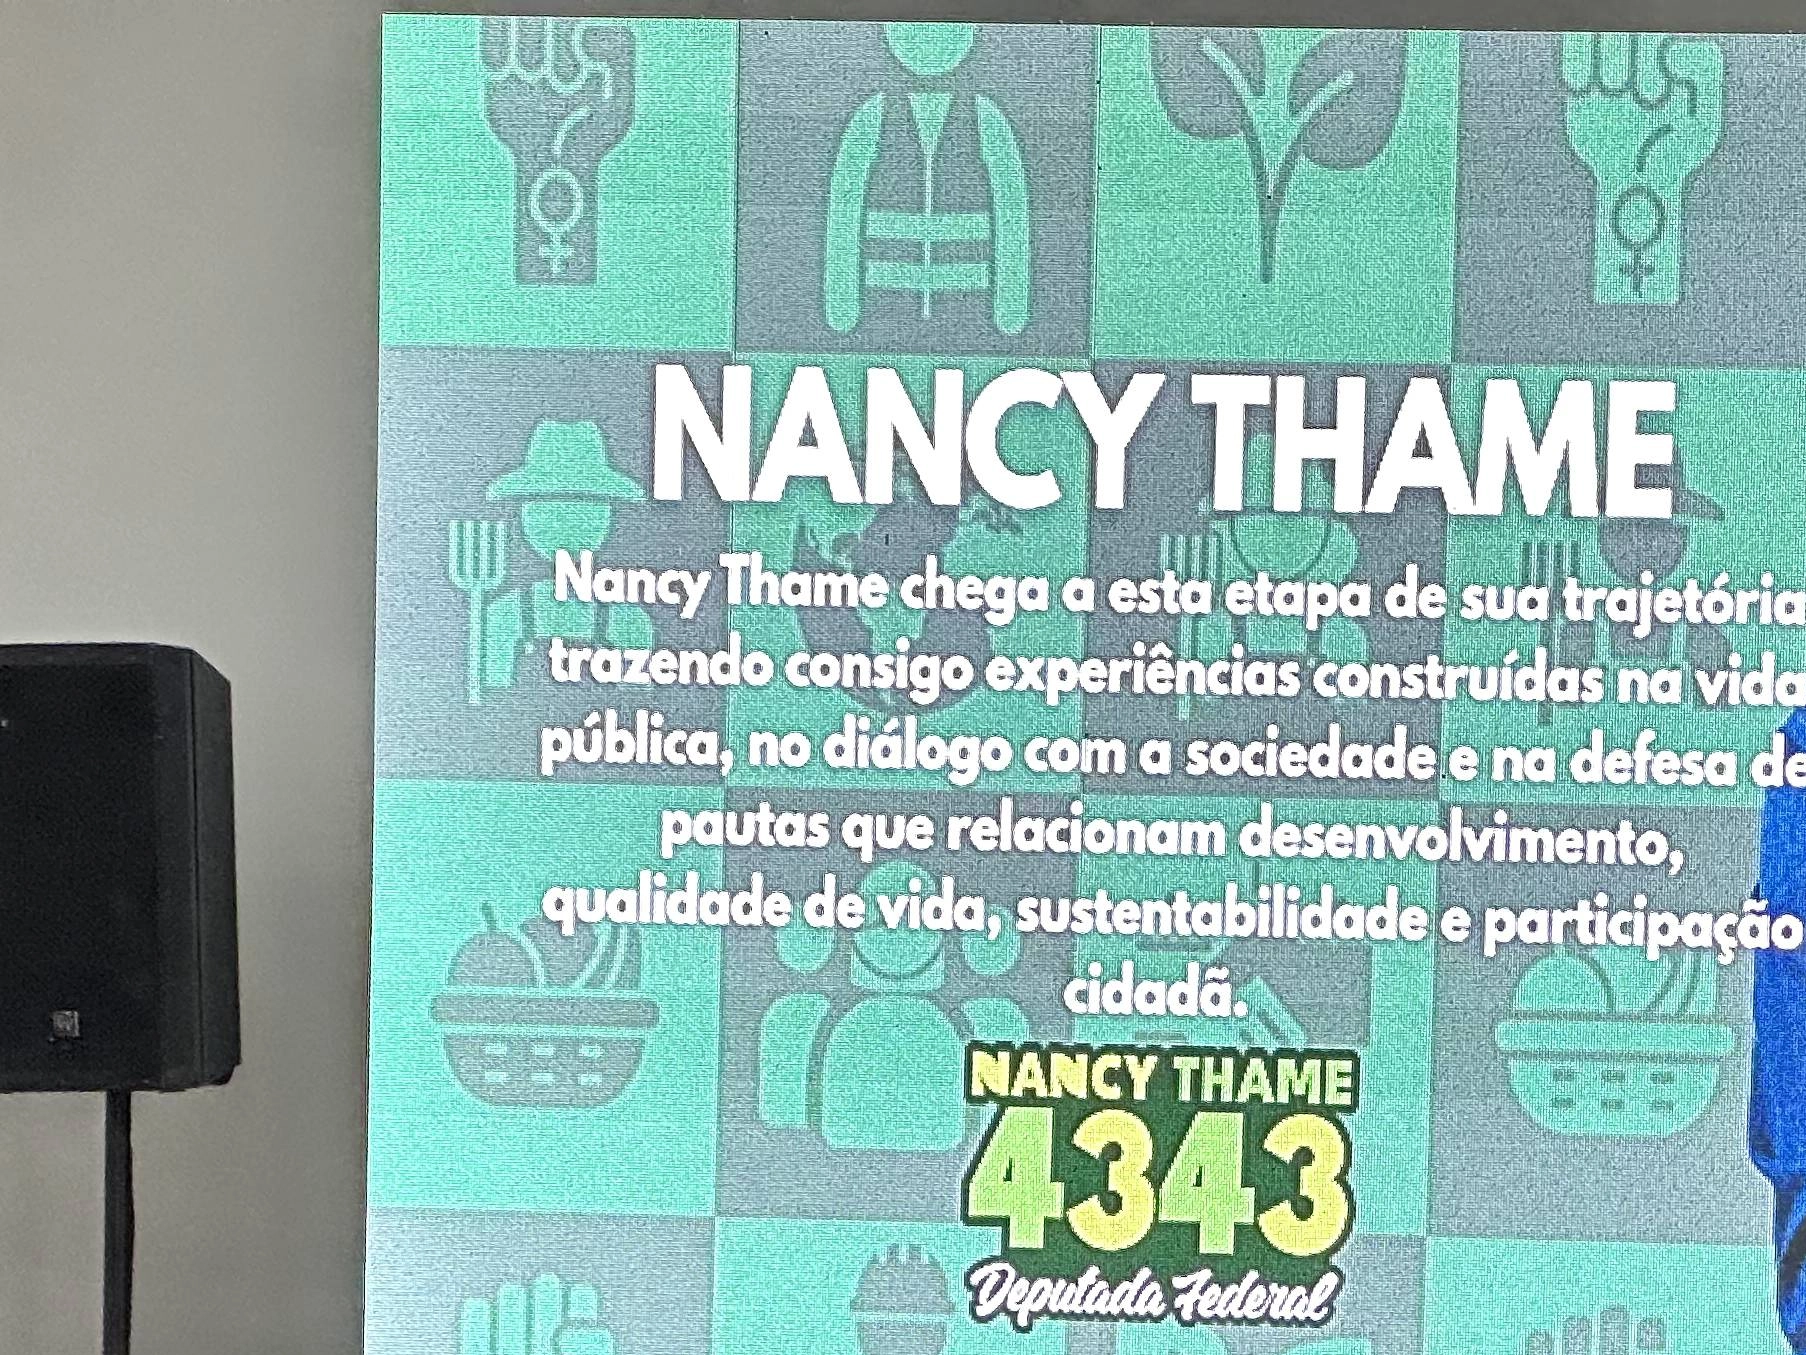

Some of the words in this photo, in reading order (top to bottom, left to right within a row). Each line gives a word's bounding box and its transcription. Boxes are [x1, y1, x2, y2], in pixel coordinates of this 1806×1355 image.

[653, 363, 1166, 510] NANCY
[1191, 373, 1676, 519] THAME
[553, 549, 711, 619] Nancy
[719, 552, 887, 609] Thame
[900, 555, 1049, 625] chega
[1062, 581, 1094, 612] a
[1108, 569, 1212, 614] esta
[1225, 571, 1371, 631] etapa
[1384, 562, 1446, 618] de
[1460, 584, 1548, 621] sua
[1562, 571, 1806, 639] trajetória
[548, 631, 773, 686] trazendo
[784, 636, 974, 705] consigo
[984, 640, 1299, 705] experiências
[1313, 647, 1603, 702] construídas
[1616, 667, 1681, 704] na
[1696, 651, 1806, 707] vida
[540, 708, 733, 776] pública,
[748, 732, 811, 768] no
[822, 713, 1012, 787] diálogo
[1024, 737, 1126, 775] com
[1139, 739, 1171, 776] a
[1186, 723, 1436, 781] sociedade
[1448, 748, 1478, 781] e
[1491, 748, 1557, 783] na
[1569, 729, 1738, 787] defesa
[660, 801, 830, 859] pautas
[841, 815, 935, 863] que
[947, 798, 1226, 857] relacionam
[1239, 802, 1684, 875] desenvolvimento,
[541, 869, 791, 936] qualidade
[803, 872, 865, 928] de
[877, 875, 1001, 939] vida,
[1015, 879, 1429, 942] sustentabilidade
[1440, 908, 1470, 943] e
[1483, 891, 1804, 965] participação
[1063, 960, 1248, 1018] cidadã.
[969, 1049, 1159, 1100] NANCY
[1173, 1056, 1353, 1104] THAME
[967, 1105, 1350, 1258] 4343
[969, 1263, 1167, 1328] Deputada
[1174, 1267, 1335, 1323] Federal
